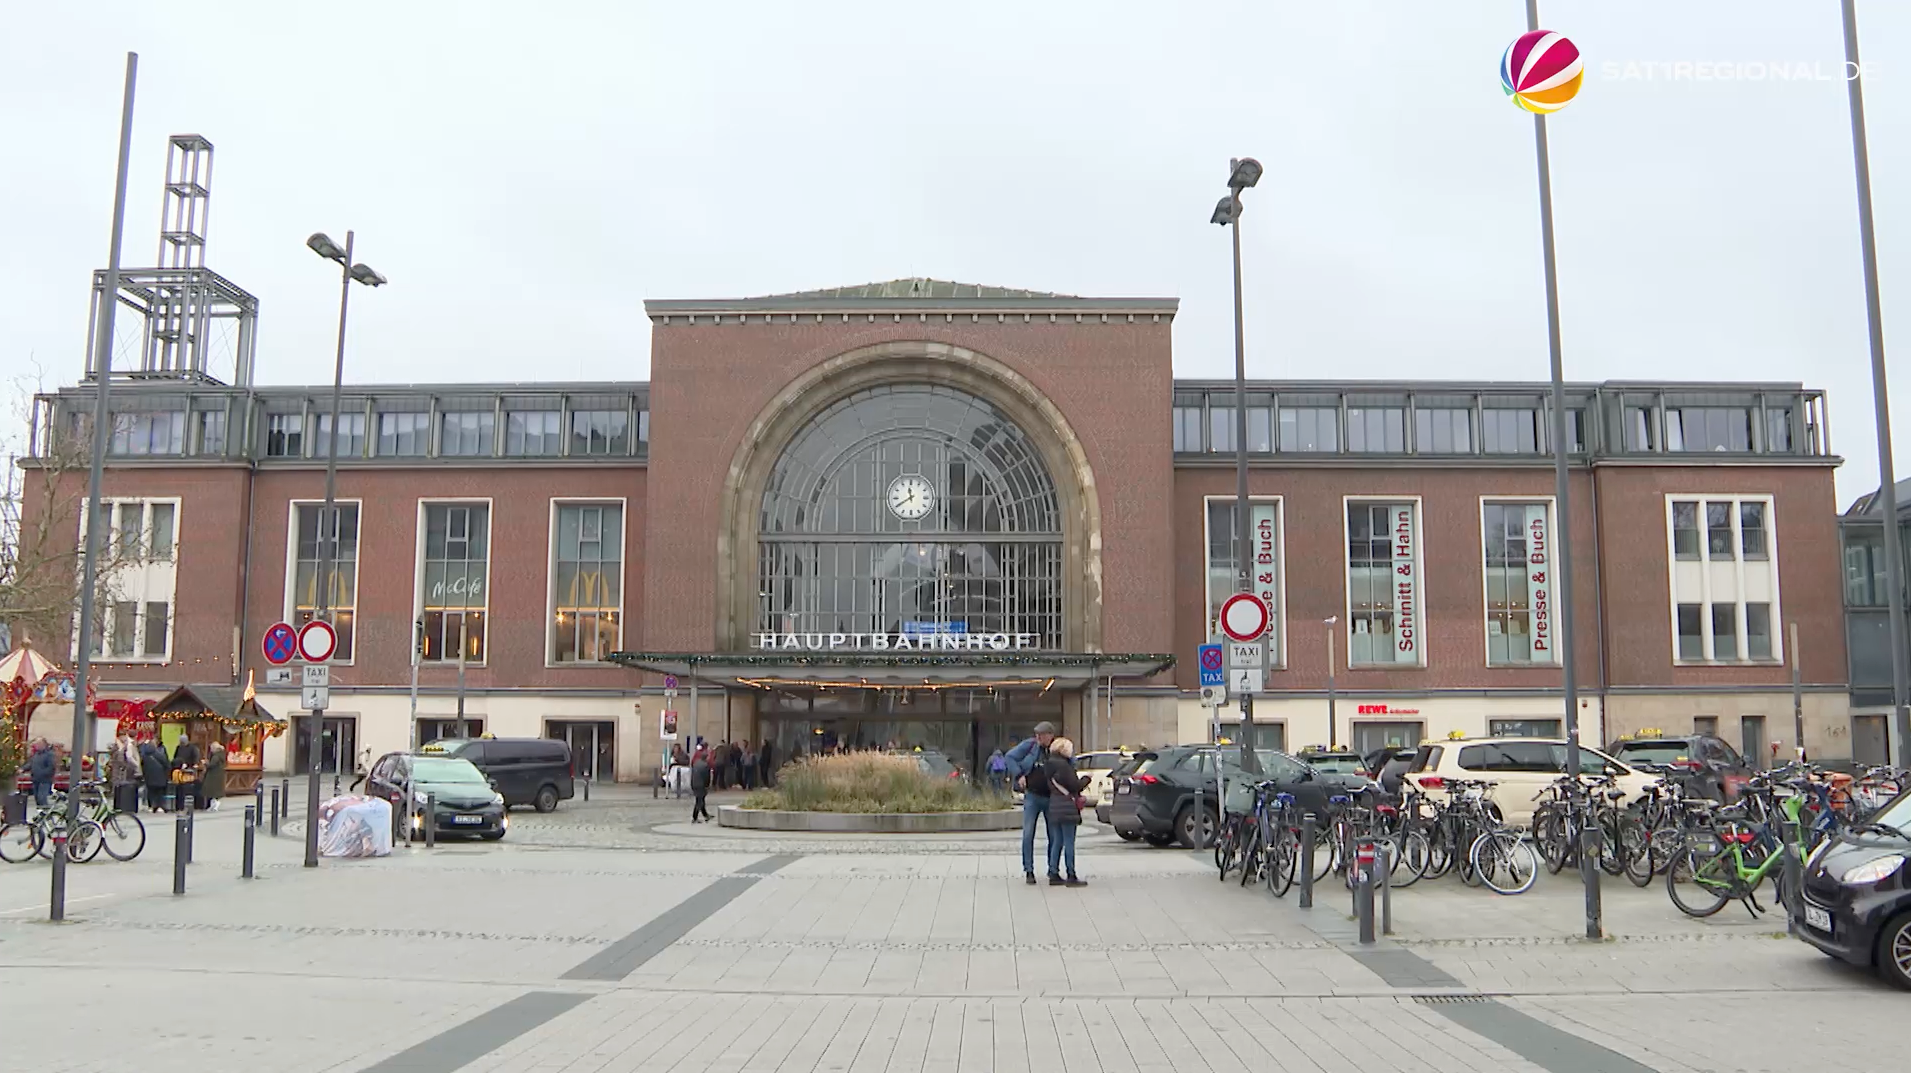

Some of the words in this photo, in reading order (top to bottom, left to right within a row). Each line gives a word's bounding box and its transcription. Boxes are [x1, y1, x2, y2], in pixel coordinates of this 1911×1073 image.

[1395, 510, 1410, 558] Hahn
[1257, 518, 1272, 564] Buch
[1529, 518, 1544, 564] Buch
[1396, 564, 1411, 577] &
[1258, 571, 1273, 584] &
[1531, 571, 1546, 584] &
[1398, 582, 1413, 652] Schmitt
[1534, 589, 1548, 651] Presse
[759, 633, 1031, 650] HAUPTBAHNHOF
[1233, 646, 1259, 656] TAXI
[306, 667, 326, 676] TAXI
[1202, 673, 1223, 682] TAX
[1358, 704, 1388, 715] REWE
